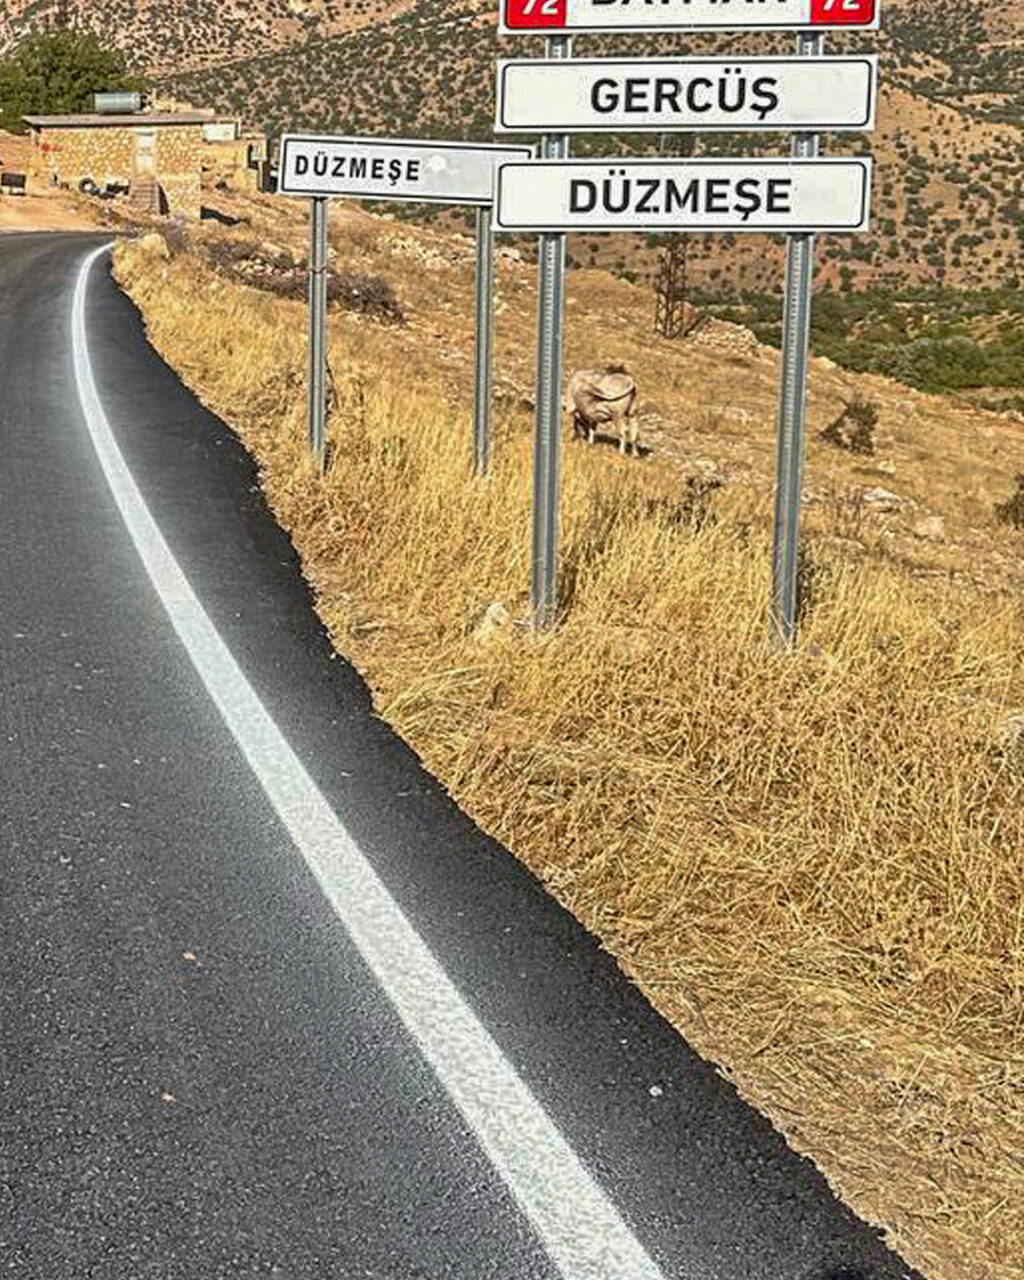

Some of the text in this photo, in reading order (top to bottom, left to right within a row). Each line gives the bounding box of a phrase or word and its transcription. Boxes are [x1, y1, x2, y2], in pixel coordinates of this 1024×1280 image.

[591, 67, 779, 121] GERCÜŞ
[294, 151, 421, 186] DÜZMEŞE
[569, 169, 793, 222] DÜZMEŞE
